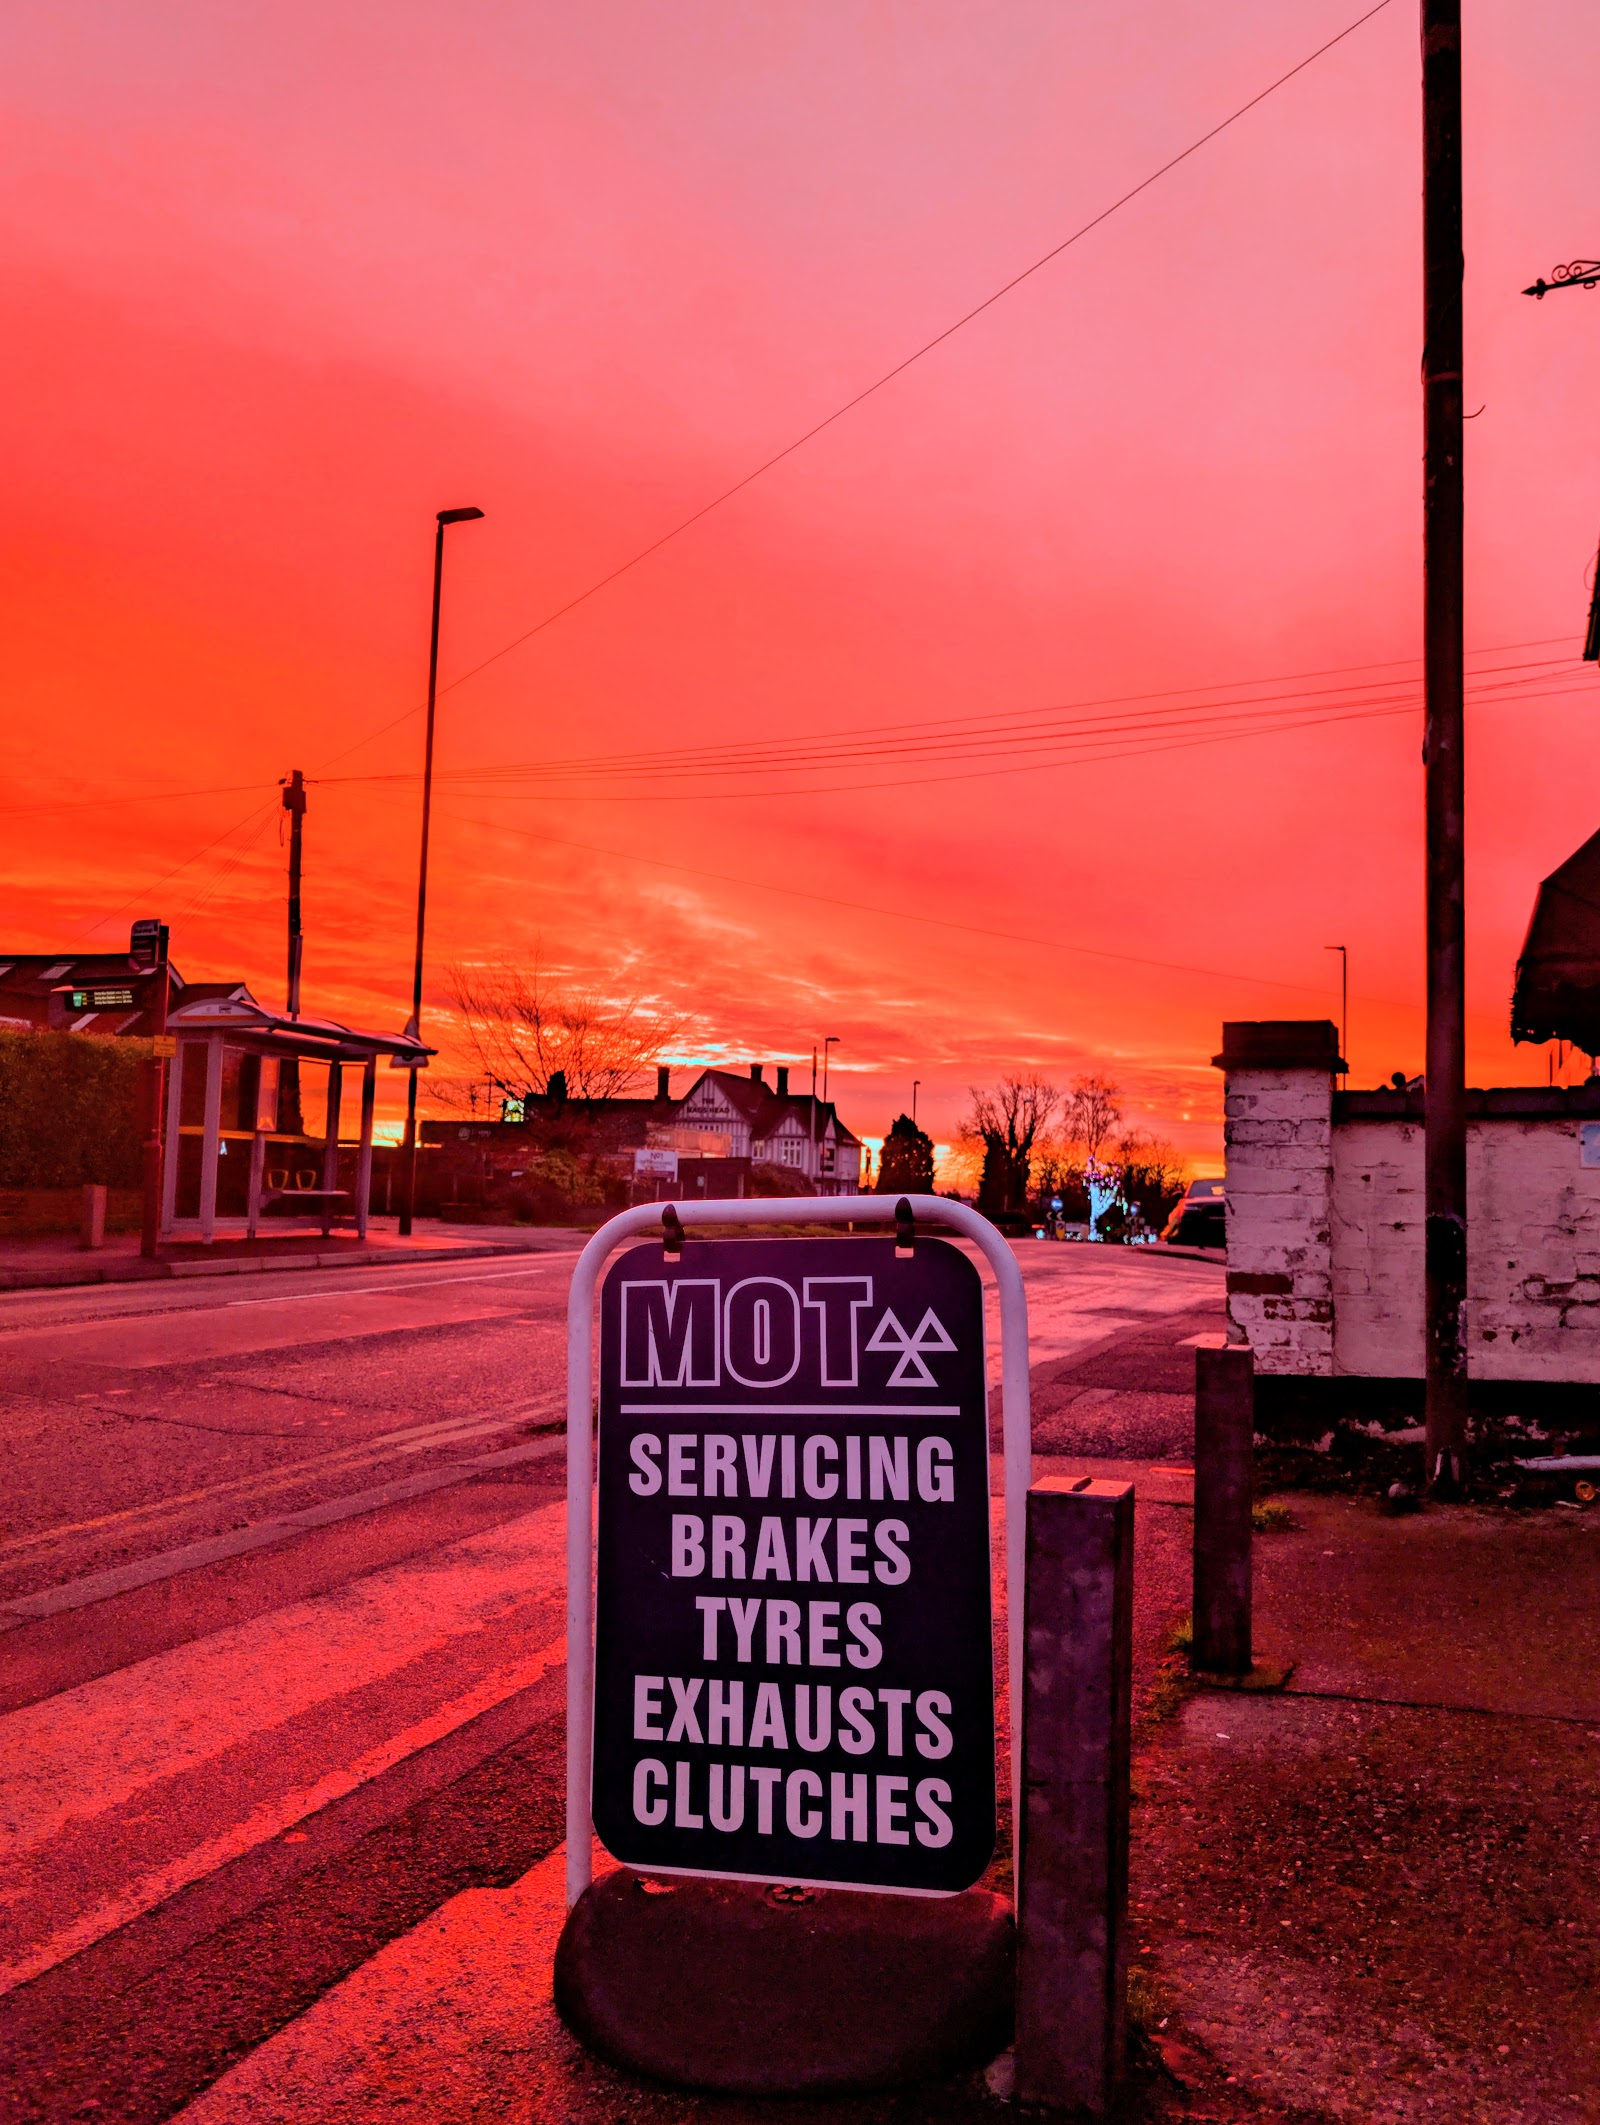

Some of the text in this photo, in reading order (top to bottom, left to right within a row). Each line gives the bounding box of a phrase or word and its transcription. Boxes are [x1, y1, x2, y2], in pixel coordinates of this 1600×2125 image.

[620, 1275, 874, 1389] MOT
[628, 1432, 955, 1503] SERVICING
[671, 1513, 911, 1586] BRAKES
[695, 1595, 883, 1670] TYRES
[633, 1674, 954, 1760] EXHAUSTS
[632, 1758, 954, 1849] CLUTCHES
